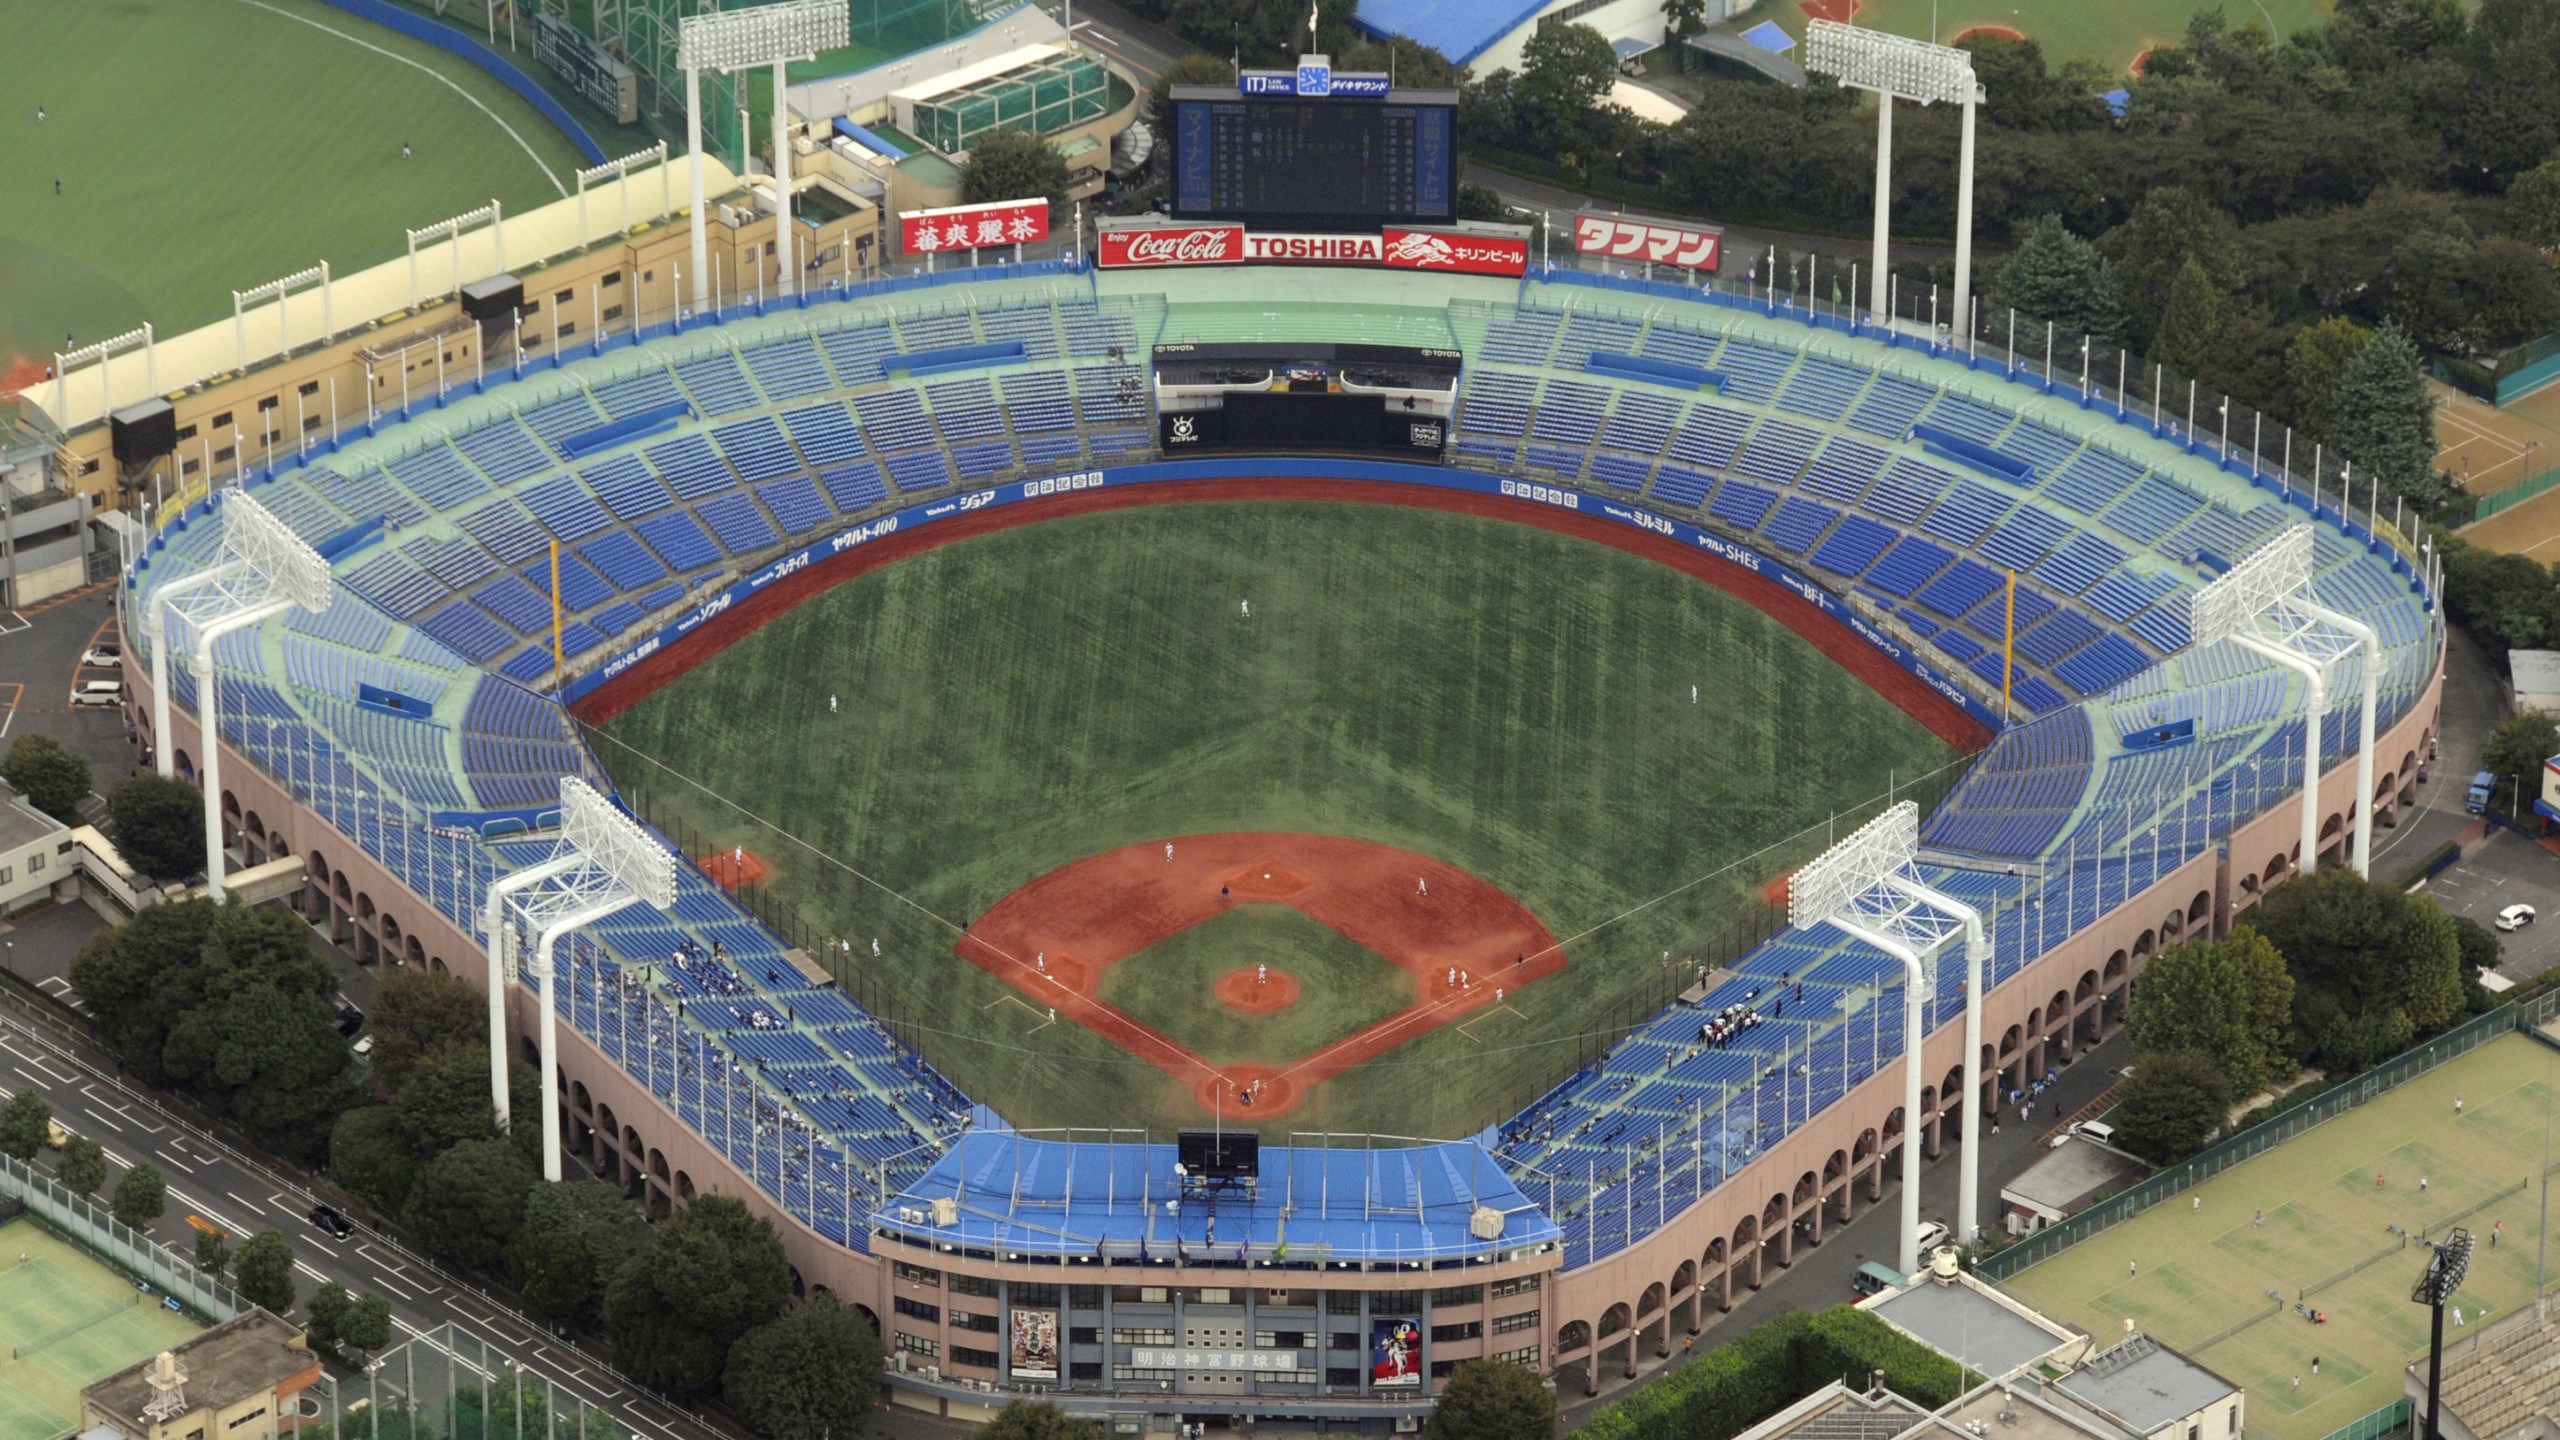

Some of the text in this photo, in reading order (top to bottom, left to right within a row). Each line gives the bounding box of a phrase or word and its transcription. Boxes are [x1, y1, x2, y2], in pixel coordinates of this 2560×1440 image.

[1246, 76, 1267, 93] ITJ
[1330, 79, 1389, 92] ダイキサウンド
[1184, 110, 1206, 180] マイナビ
[912, 215, 1039, 251] 蕃爽麗茶
[1107, 233, 1129, 243] Enjoy
[1578, 217, 1715, 266] タフマン
[1250, 237, 1377, 258] TOSHIBA
[1454, 247, 1524, 264] キリンビール
[1165, 344, 1195, 352] TOYOTA
[1433, 350, 1461, 358] TOYOTA
[1169, 434, 1199, 443] フジテレビ
[959, 490, 996, 511] ジョア
[1603, 505, 1675, 536] Yakult ミルミル
[1137, 1351, 1292, 1369] 明治神宮野球場
